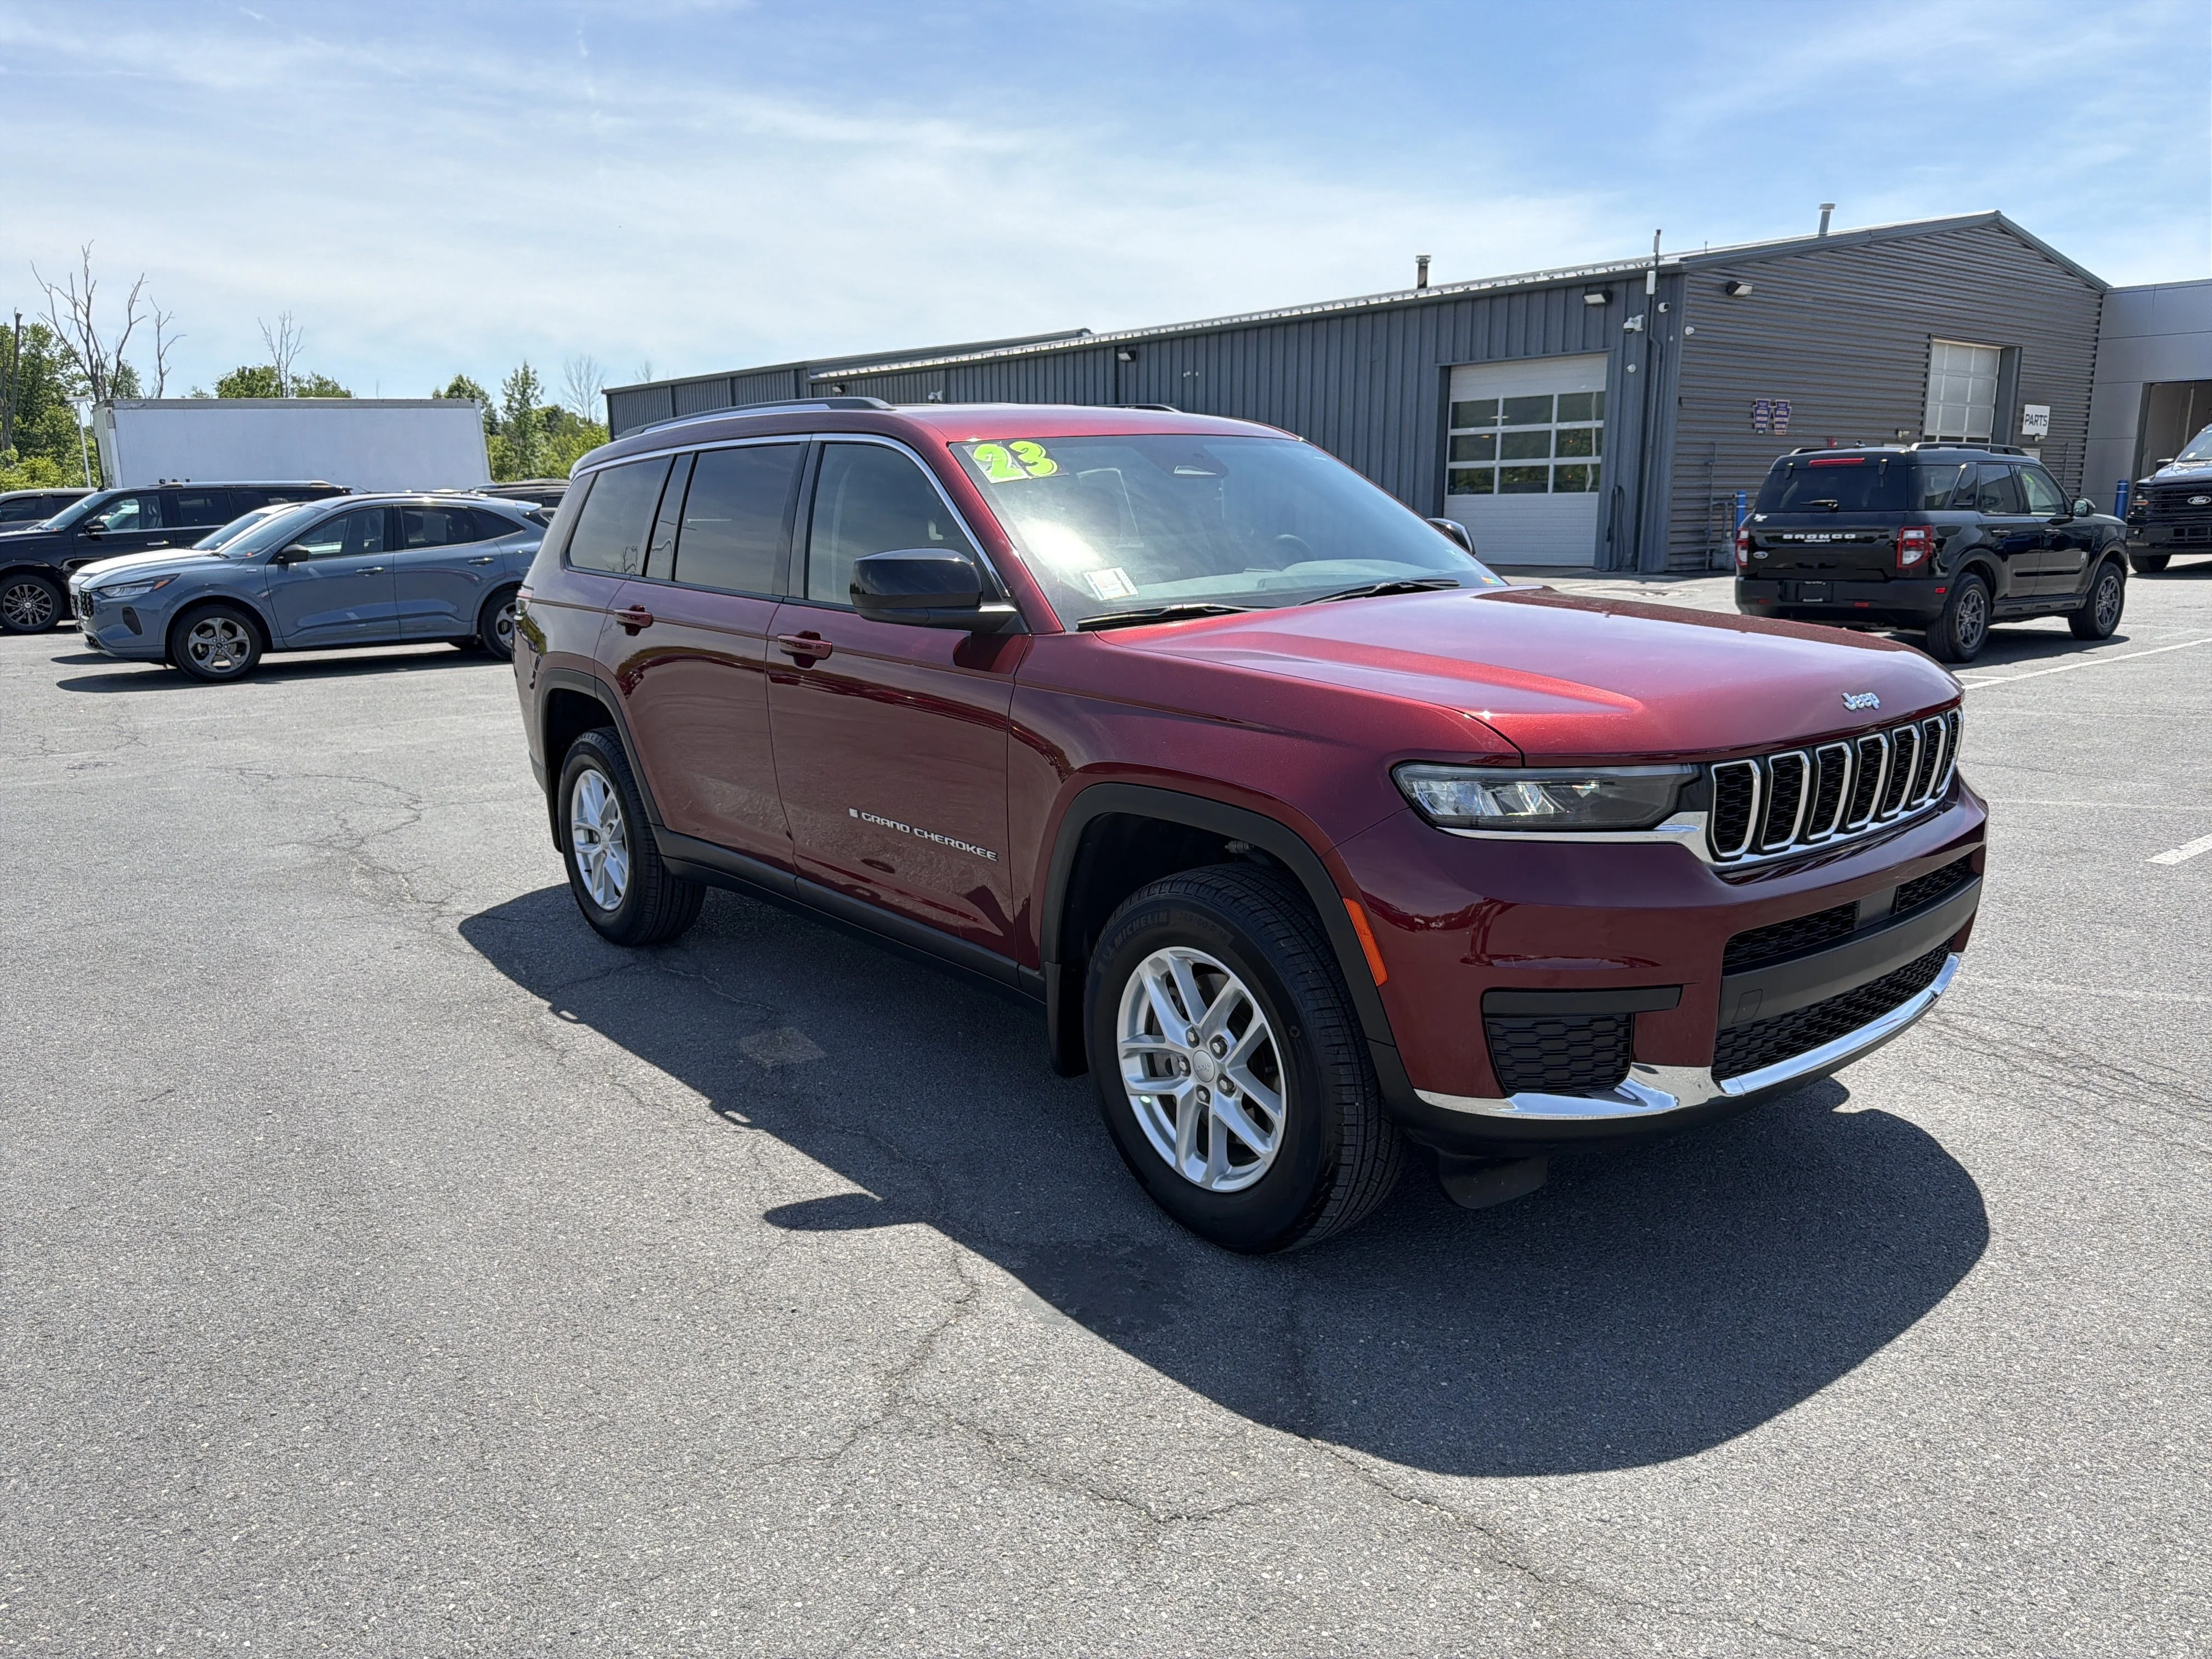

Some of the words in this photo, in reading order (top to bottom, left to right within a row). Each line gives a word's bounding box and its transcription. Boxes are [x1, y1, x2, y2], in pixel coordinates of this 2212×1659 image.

[2024, 414, 2048, 427] PARTS
[974, 441, 1058, 480] 23
[1843, 693, 1880, 710] Jeep
[861, 812, 911, 833] GRAND
[913, 828, 998, 862] CHEROKEE
[1114, 912, 1168, 950] MICHELIN
